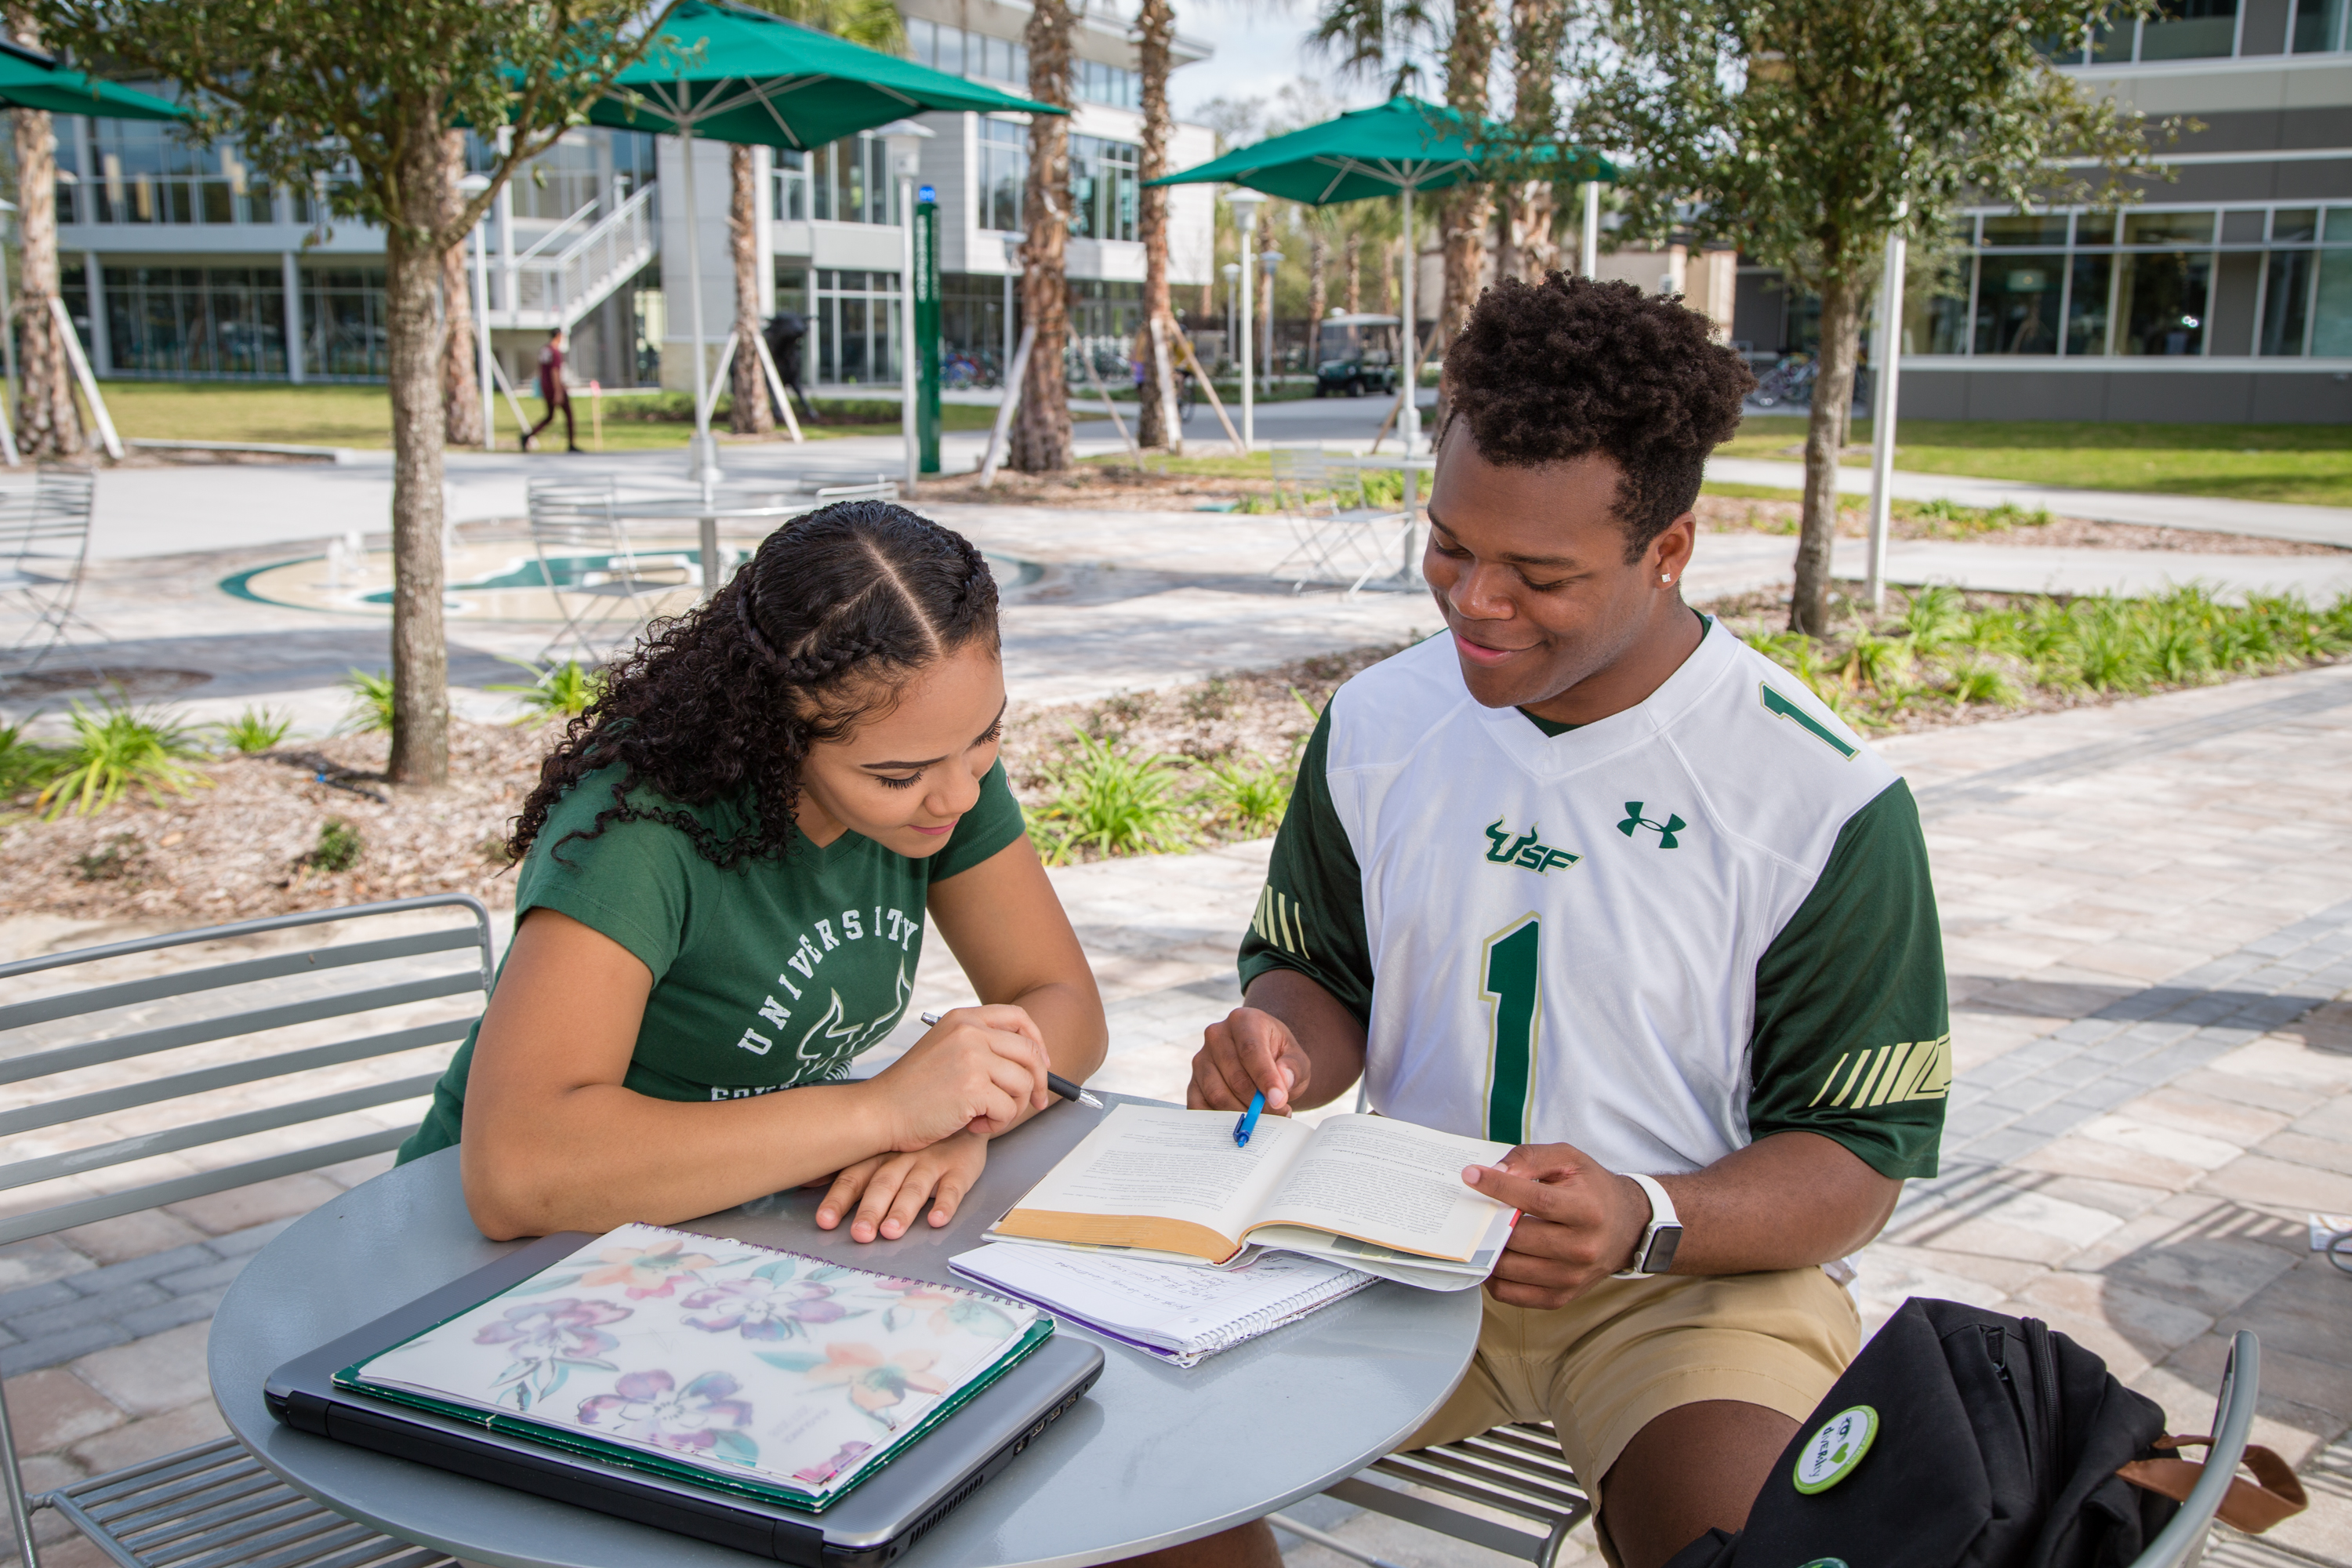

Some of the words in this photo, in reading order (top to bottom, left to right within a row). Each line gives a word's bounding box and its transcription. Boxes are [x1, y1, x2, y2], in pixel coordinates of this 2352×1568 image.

[1759, 680, 1861, 762] 1
[1483, 814, 1584, 875] USF
[737, 906, 919, 1056] UNIVERSITY
[1478, 909, 1542, 1145] 1
